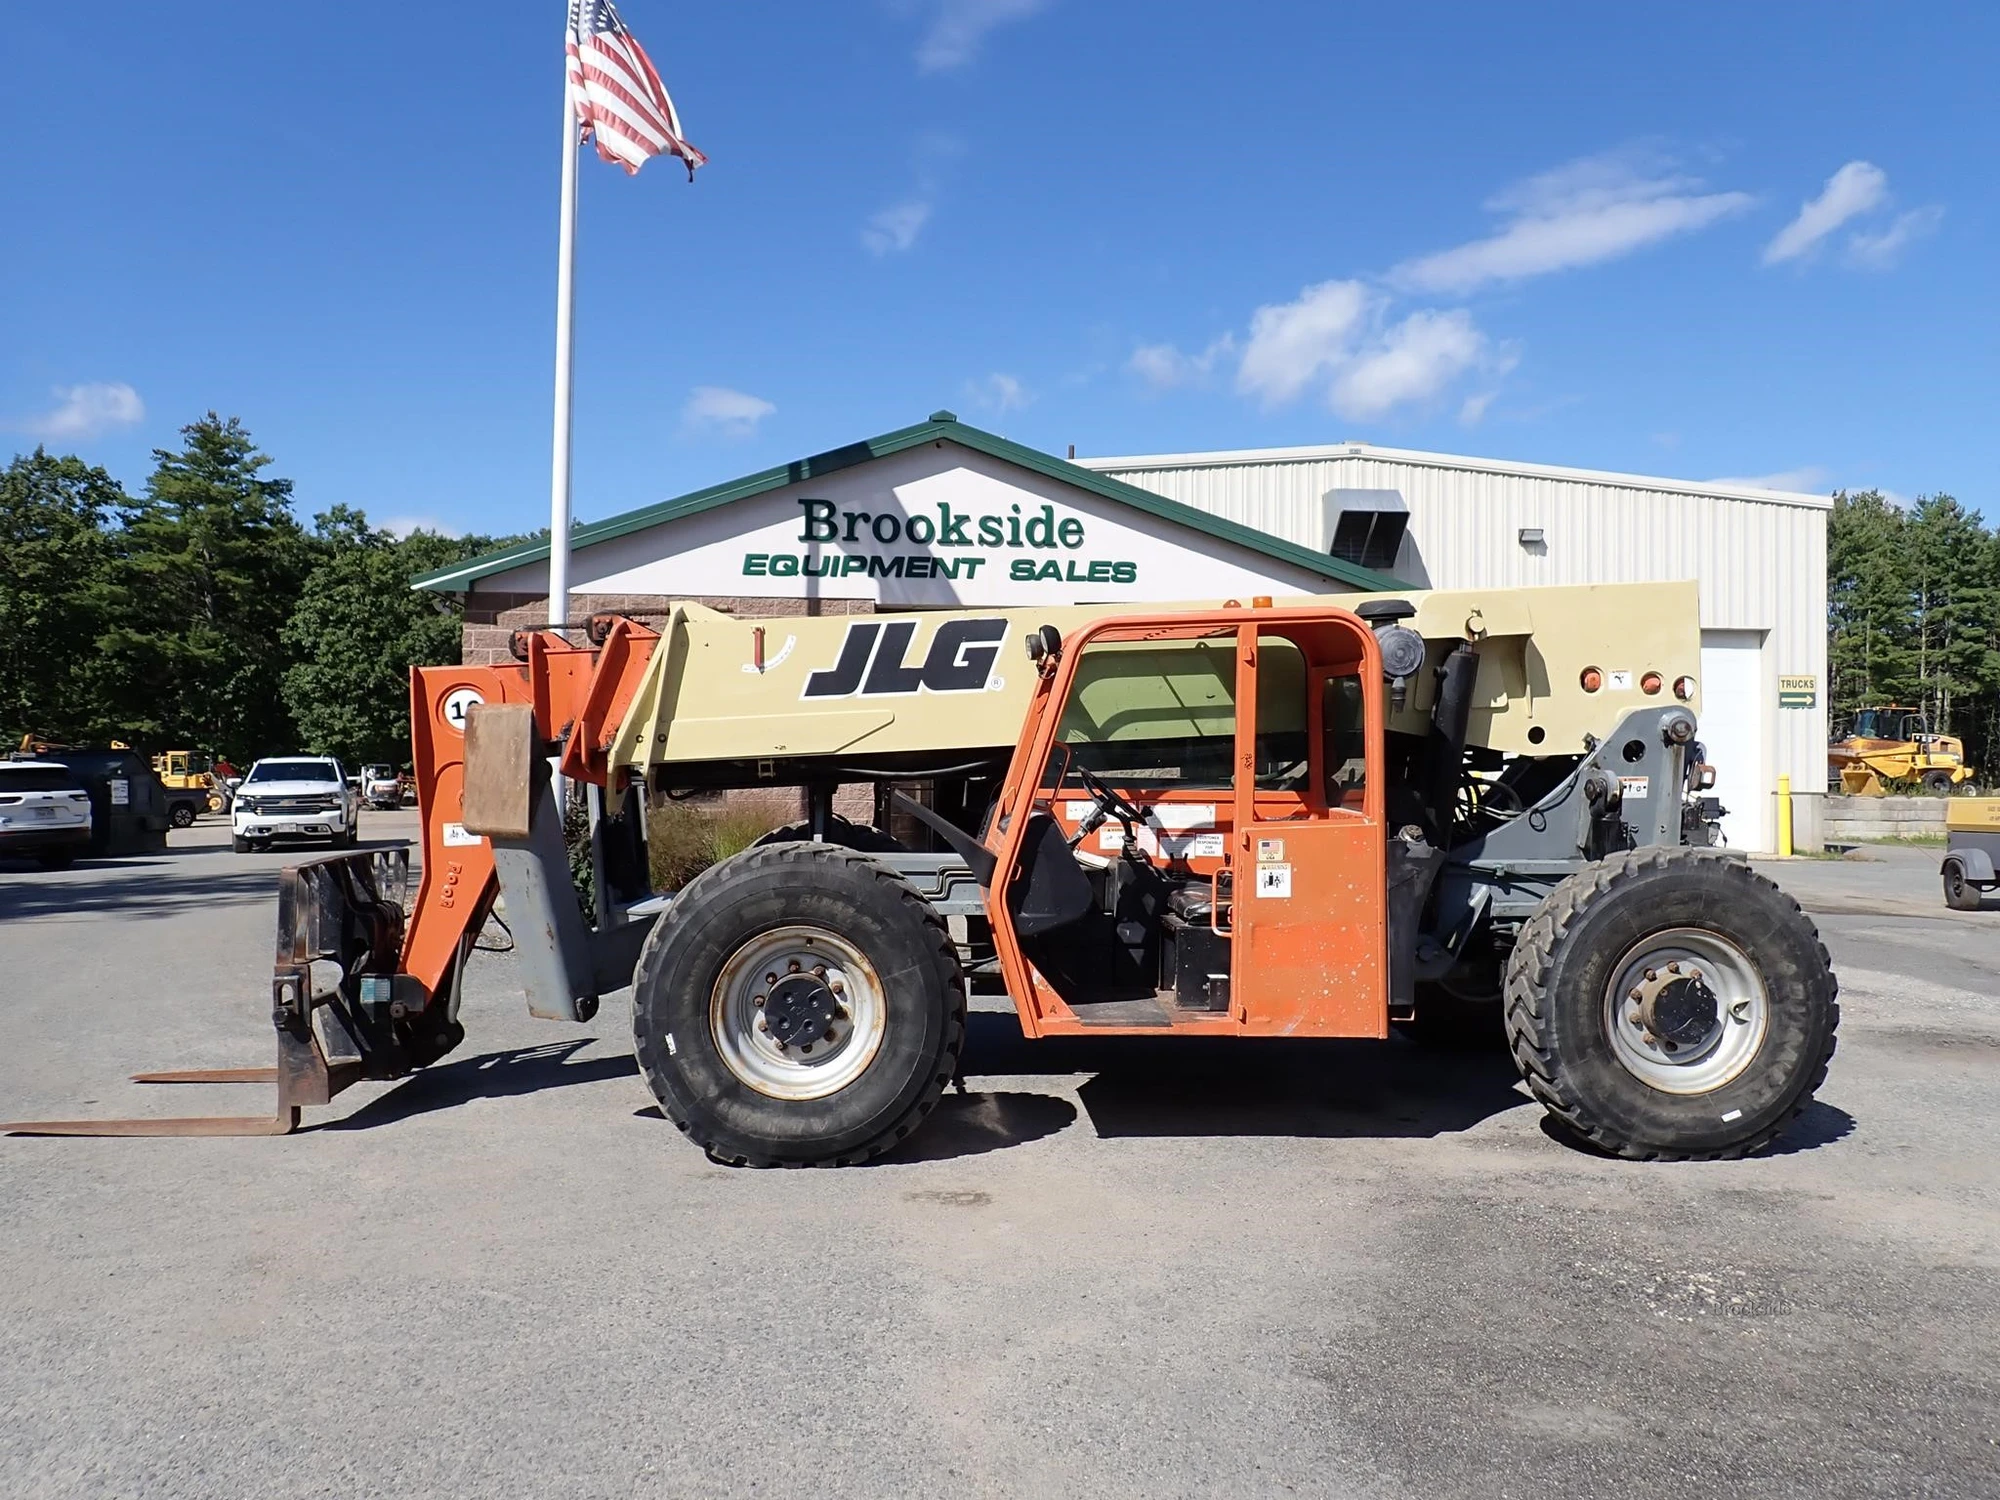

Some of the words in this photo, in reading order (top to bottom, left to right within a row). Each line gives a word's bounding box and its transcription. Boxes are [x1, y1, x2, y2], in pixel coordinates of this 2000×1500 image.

[798, 498, 1085, 548] Brookside
[742, 553, 985, 580] EQUIPMENT
[1009, 558, 1137, 583] SALES
[803, 618, 1009, 698] JLG
[1780, 679, 1815, 689] TRUCKS
[451, 700, 480, 720] 1
